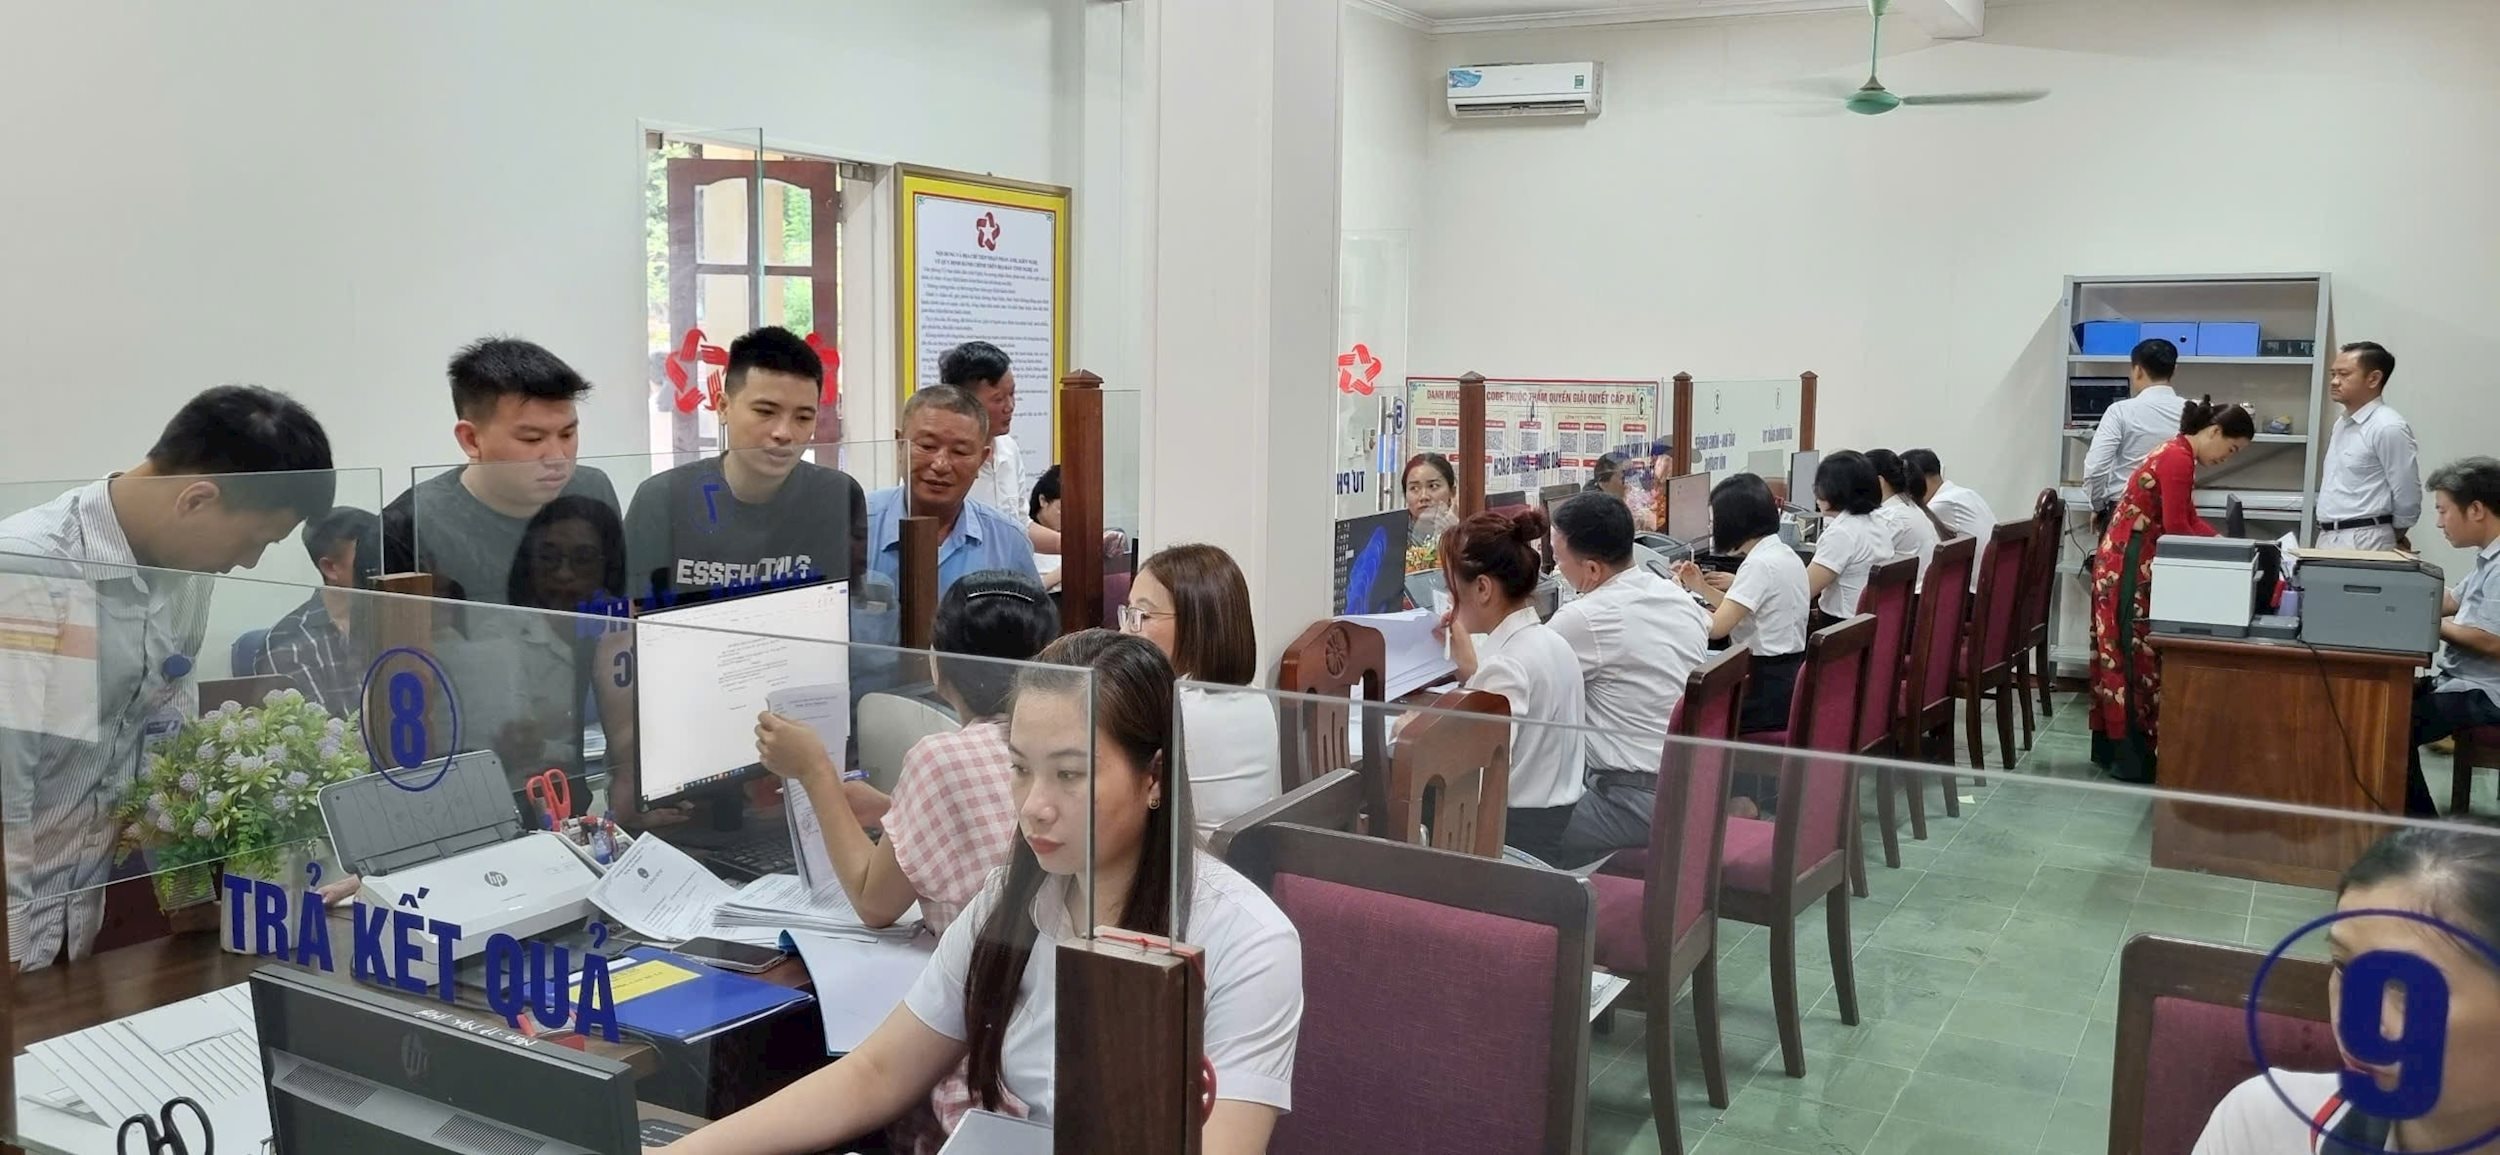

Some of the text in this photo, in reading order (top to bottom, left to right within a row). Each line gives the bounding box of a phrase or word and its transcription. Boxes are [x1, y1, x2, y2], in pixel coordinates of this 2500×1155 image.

[1427, 390, 1445, 400] DANH
[389, 672, 427, 769] 8
[484, 871, 508, 887] hp
[223, 862, 621, 1044] TRẢ KẾT QUẢ
[2338, 949, 2450, 1121] 9
